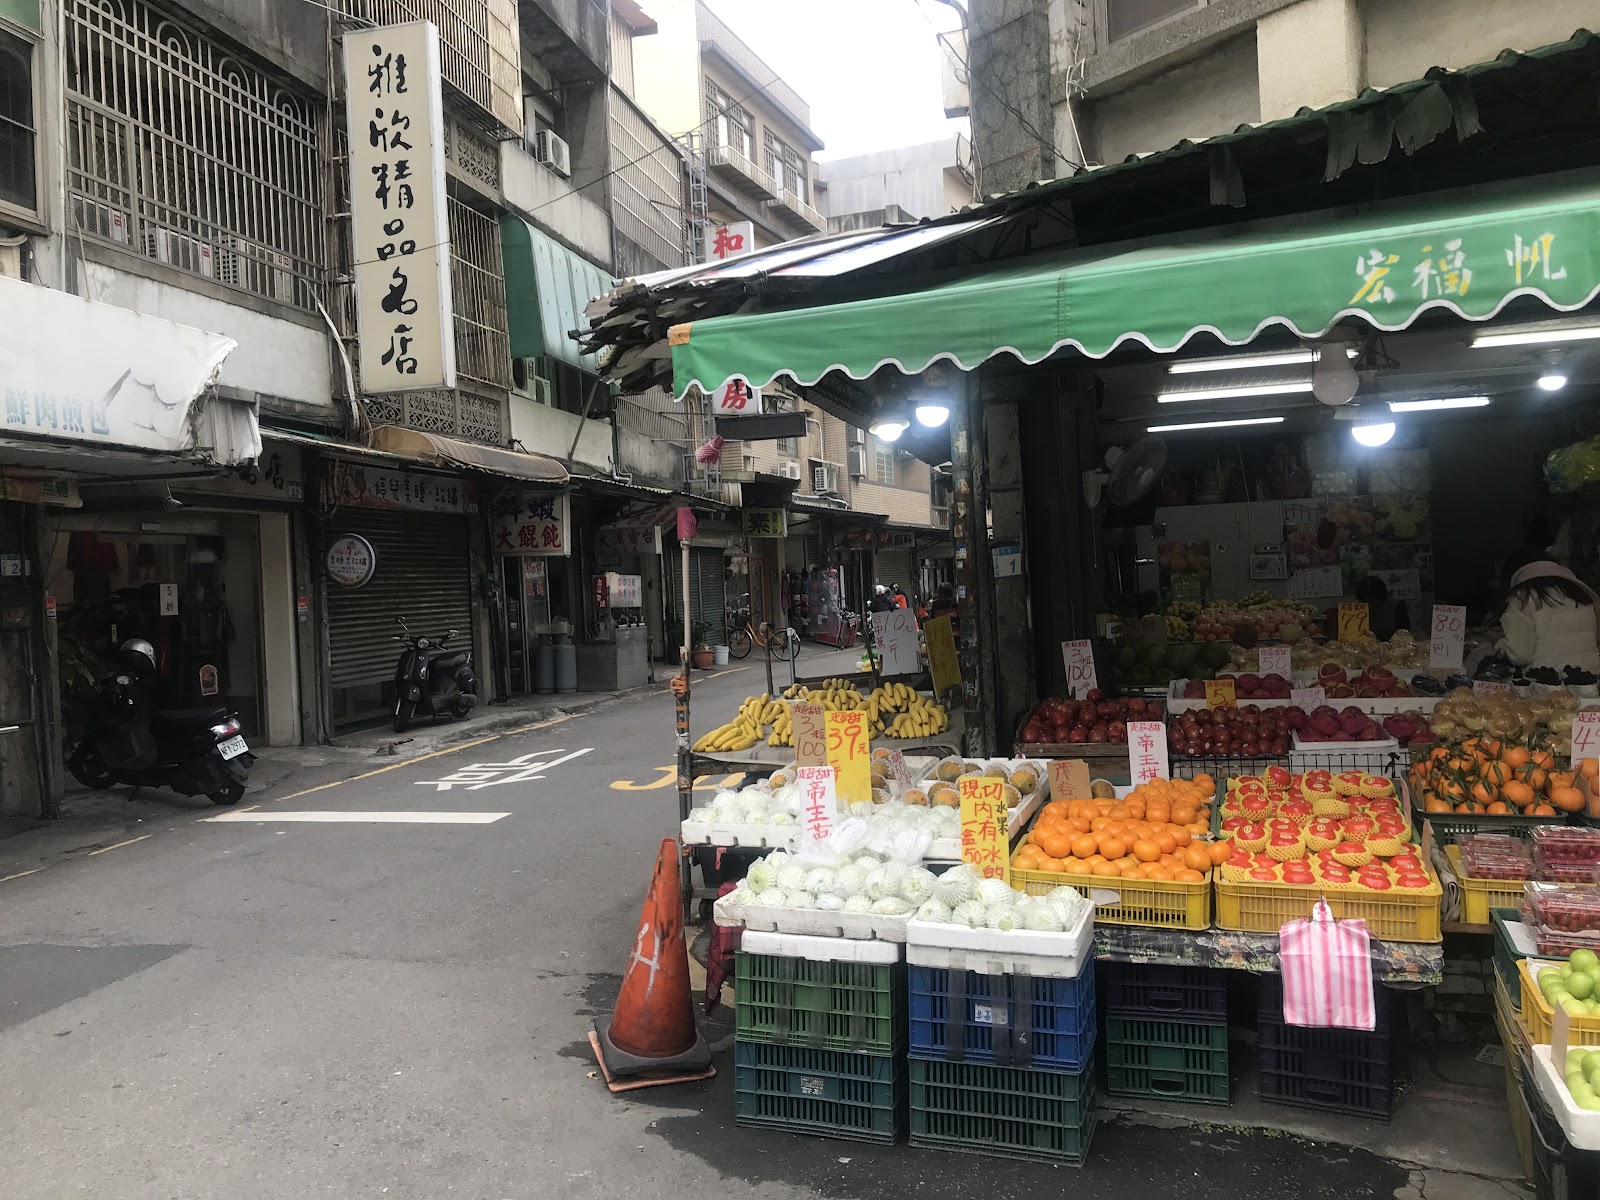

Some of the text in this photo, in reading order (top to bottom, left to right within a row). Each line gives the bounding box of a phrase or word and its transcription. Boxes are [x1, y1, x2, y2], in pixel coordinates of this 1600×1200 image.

[368, 44, 418, 375] 雅欣精品名店
[712, 228, 744, 260] 和
[4, 387, 110, 436] 鮮肉煎包
[495, 523, 562, 550] 大餛飩
[1340, 610, 1368, 632] 79
[1434, 613, 1462, 633] 80
[1067, 664, 1094, 685] 100
[1259, 656, 1288, 671] 50
[829, 711, 864, 725] 超甜
[1130, 721, 1162, 732] 超甜
[1577, 712, 1600, 723] 超
[796, 737, 826, 761] 100
[1573, 725, 1600, 752] 4
[1136, 733, 1161, 781] 帝王柑
[798, 767, 835, 780] 超甜
[1053, 761, 1078, 800] 茂谷
[960, 779, 1003, 801] 現切
[996, 800, 1009, 837] 水果
